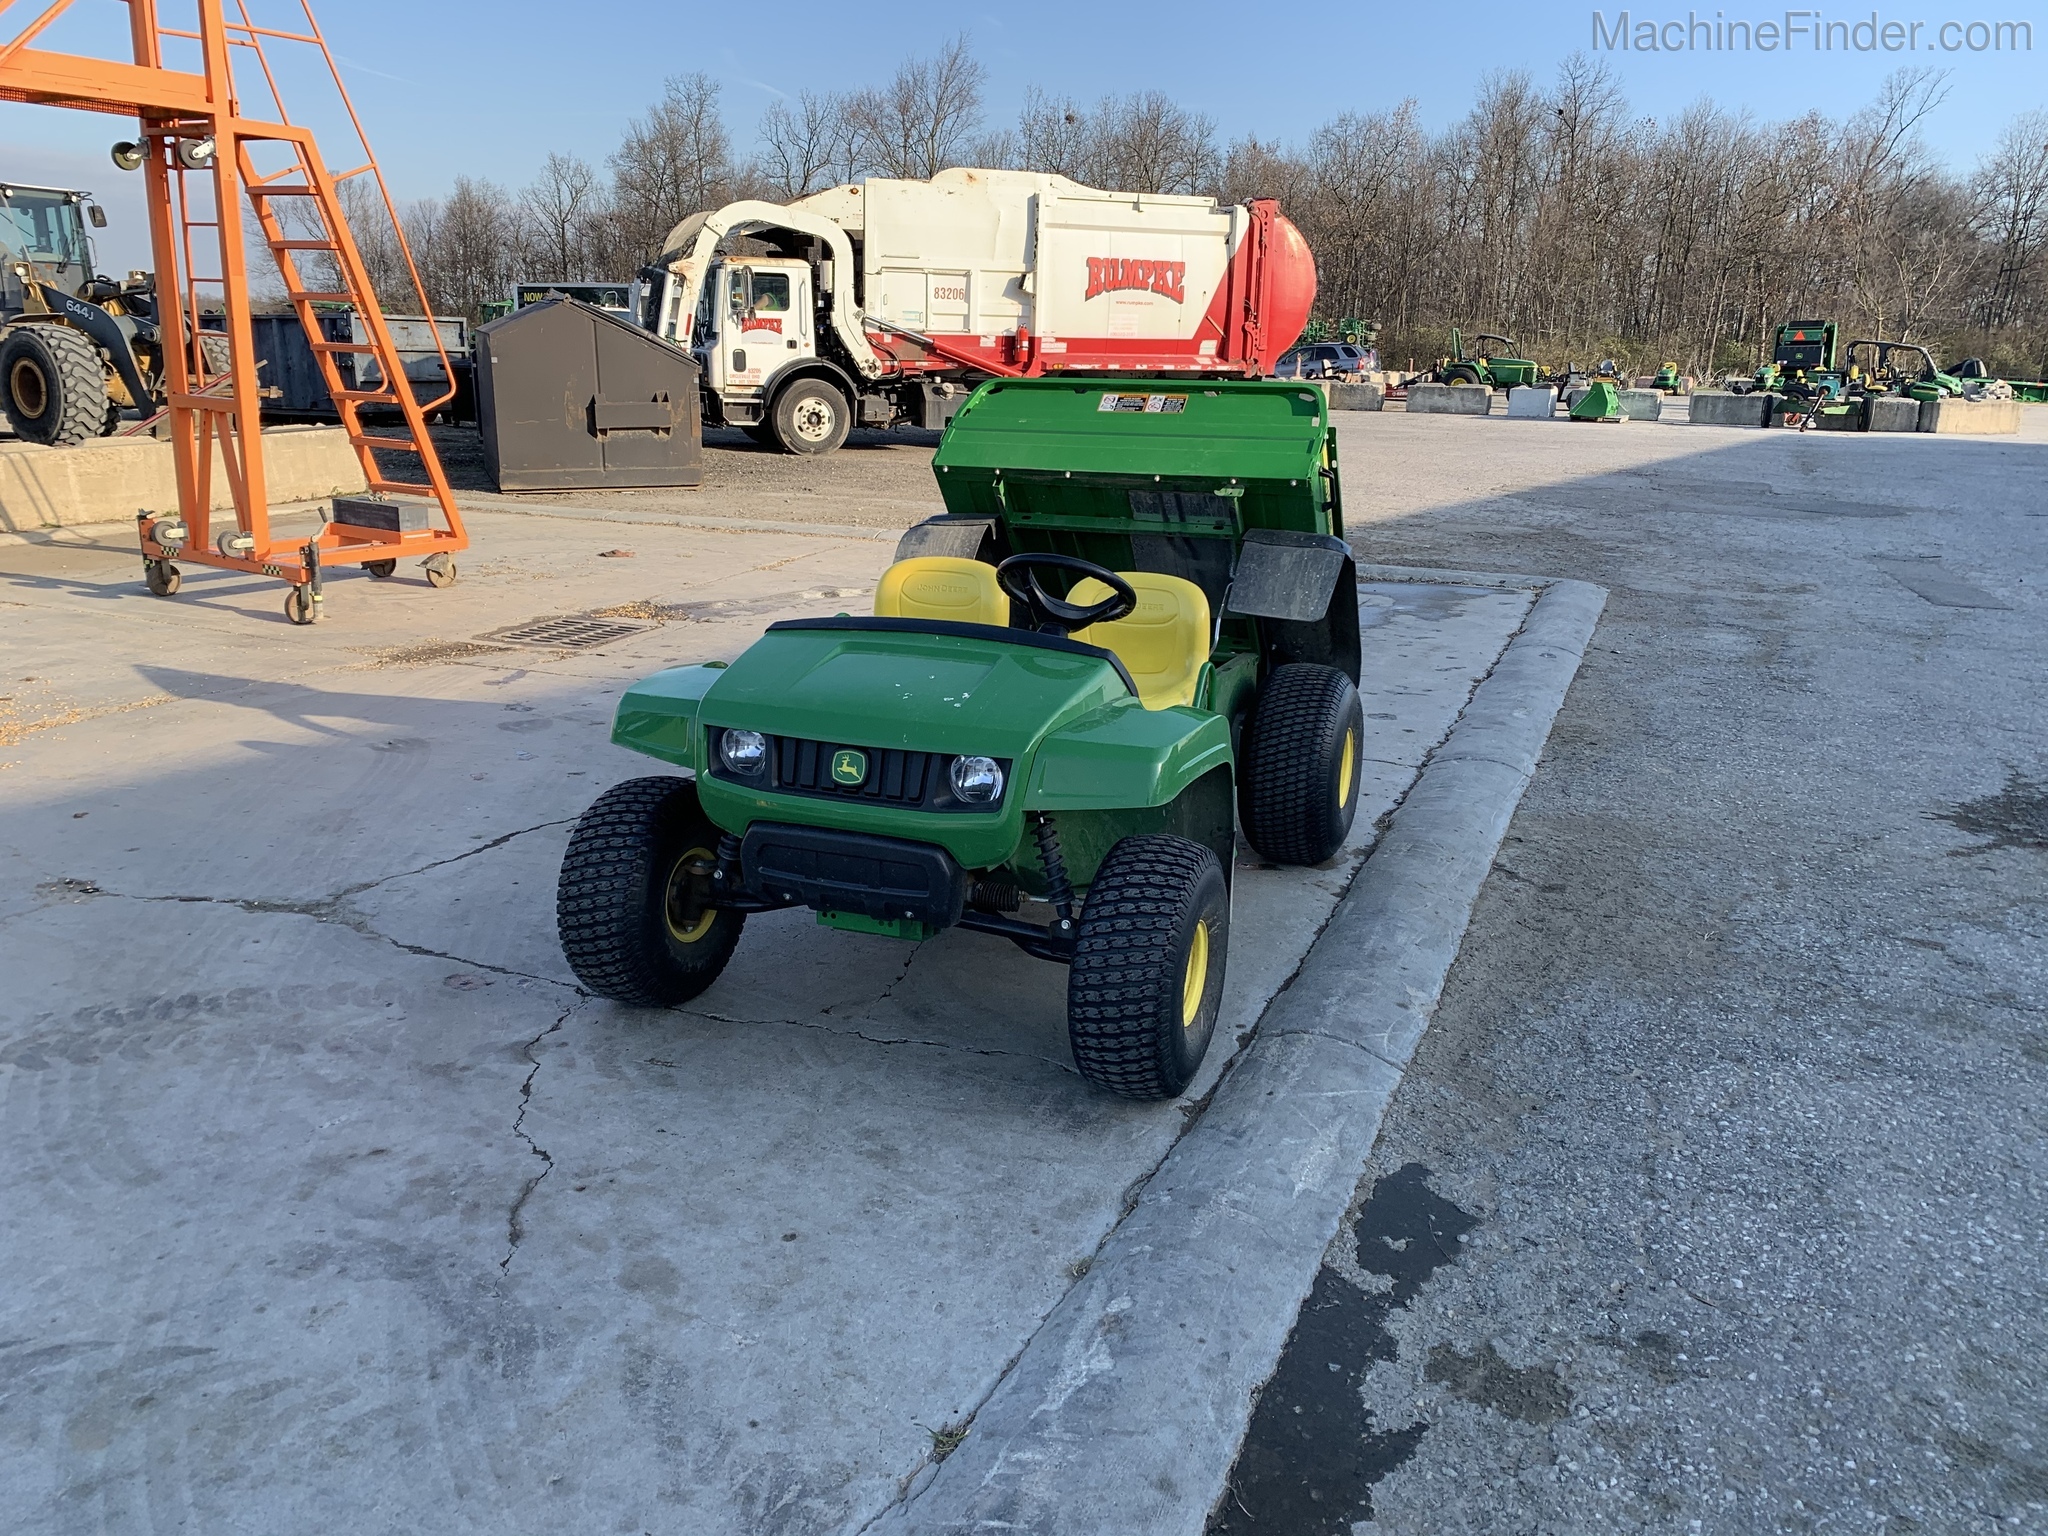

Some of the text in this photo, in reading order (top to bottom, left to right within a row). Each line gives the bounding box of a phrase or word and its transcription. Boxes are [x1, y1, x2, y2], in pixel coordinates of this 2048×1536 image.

[1084, 256, 1185, 305] RUMPKE
[523, 292, 543, 303] NOW
[934, 286, 965, 301] 83206
[66, 299, 94, 320] 644J
[741, 318, 782, 335] RUMPKE
[917, 583, 940, 592] JOHN
